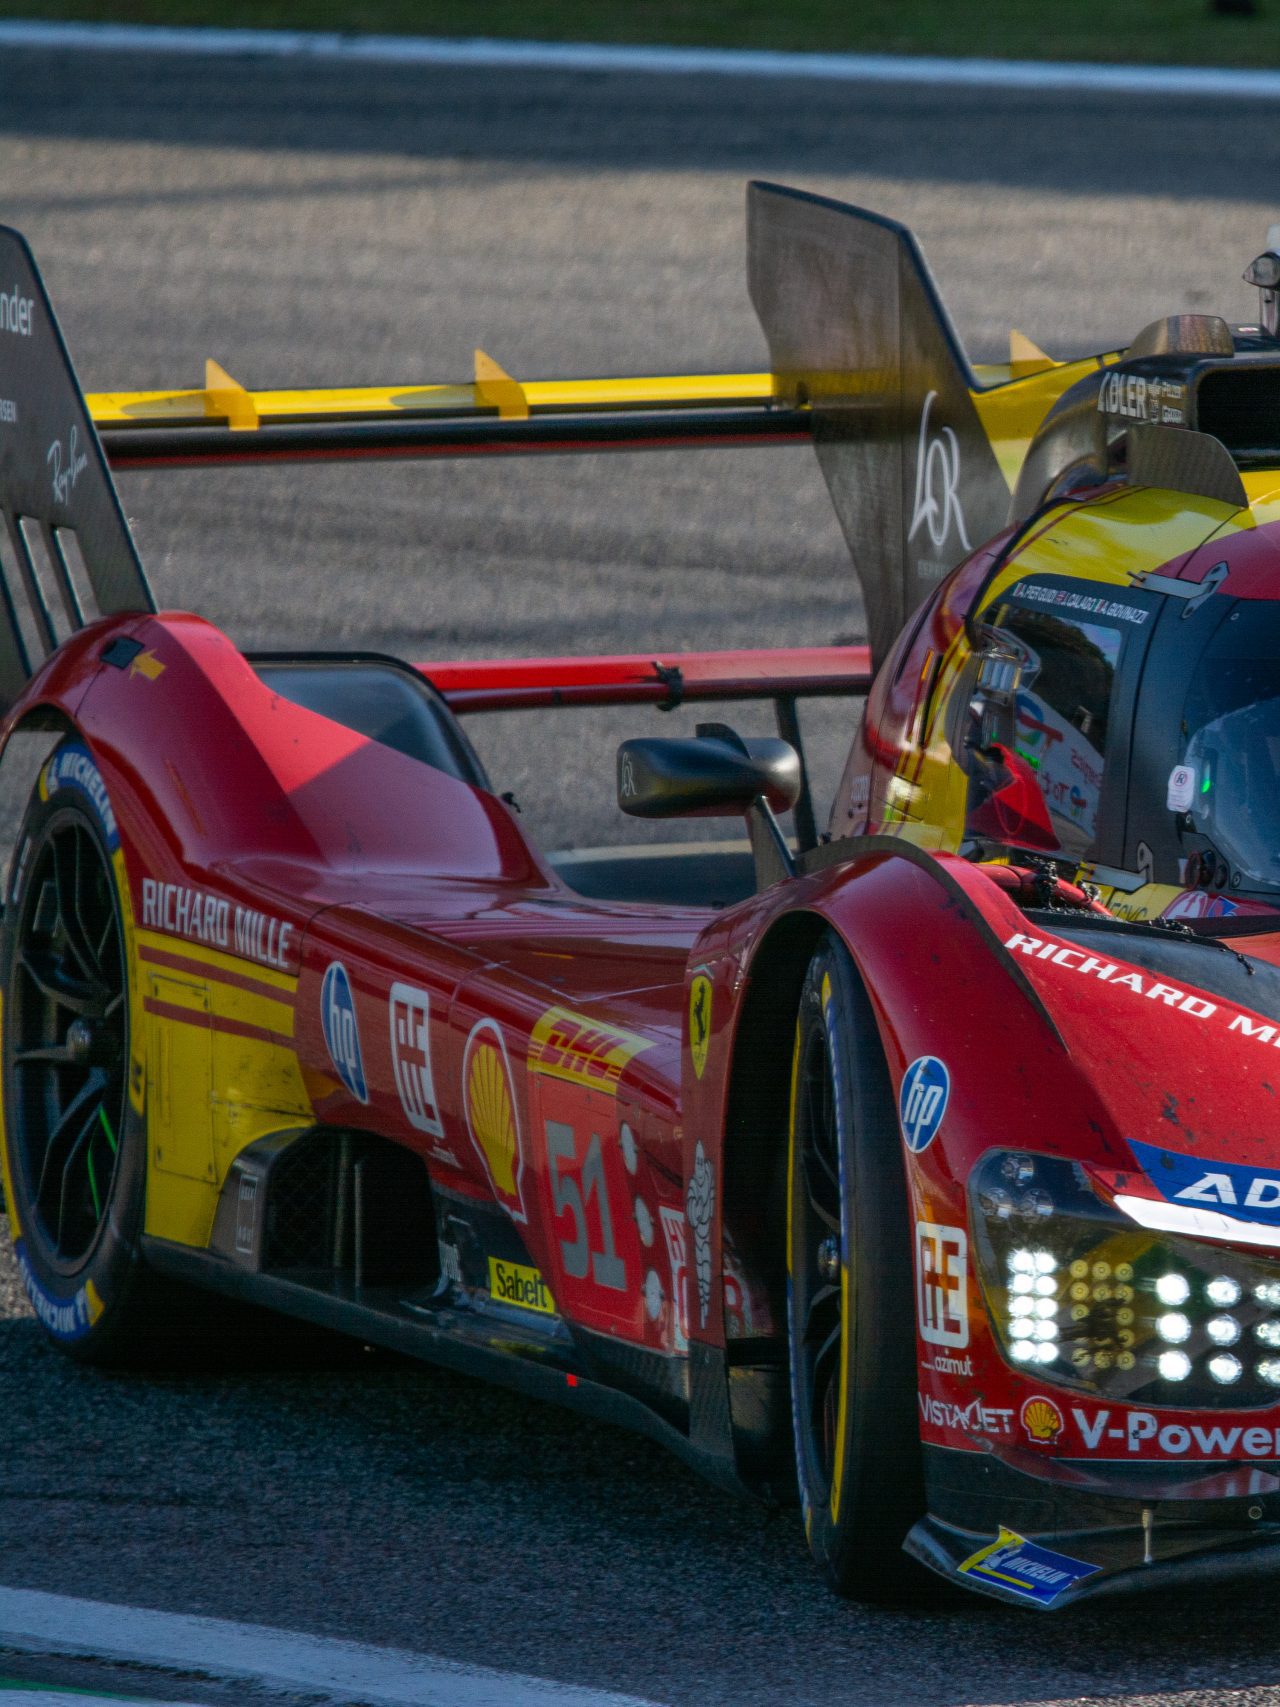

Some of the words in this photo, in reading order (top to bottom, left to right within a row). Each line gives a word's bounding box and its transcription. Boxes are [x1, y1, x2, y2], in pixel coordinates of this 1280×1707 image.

[142, 877, 230, 947] RICHARD
[234, 905, 294, 969] MILLE
[1004, 933, 1218, 1019] RICHARD
[903, 1058, 945, 1150] hp
[545, 1119, 627, 1292] 51
[496, 1262, 547, 1309] Sabelt
[934, 1347, 973, 1377] azimut
[1001, 1557, 1072, 1585] MICHELIN
